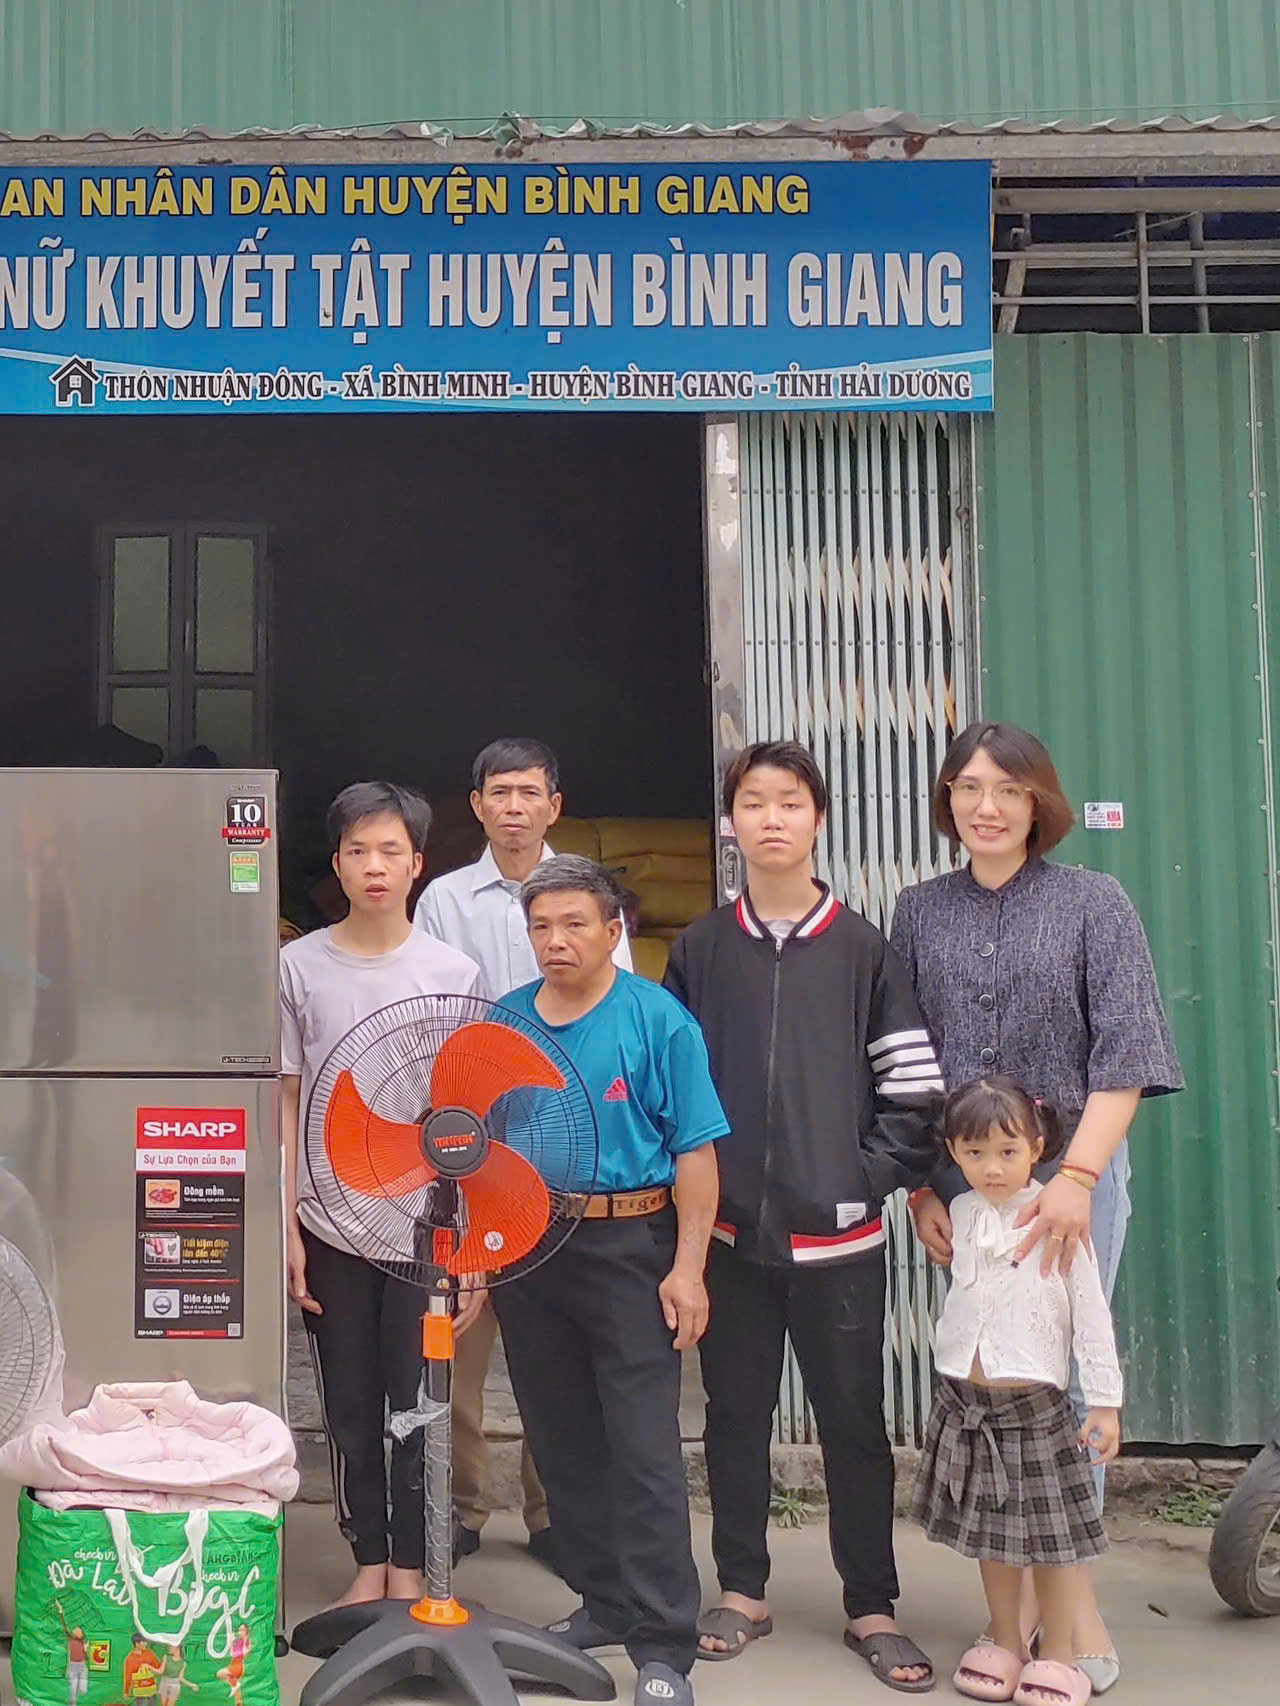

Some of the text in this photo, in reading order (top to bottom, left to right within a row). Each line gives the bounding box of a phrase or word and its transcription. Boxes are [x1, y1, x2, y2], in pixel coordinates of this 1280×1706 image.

[80, 167, 213, 216] NHÂN
[230, 167, 327, 215] DÂN
[344, 168, 508, 223] HUYỆN
[524, 167, 640, 215] BÌNH
[657, 176, 810, 215] GIANG
[86, 228, 295, 329] KHUYẾT
[312, 241, 410, 344] TẬT
[430, 239, 612, 344] HUYỆN
[633, 238, 767, 327] BÌNH
[788, 252, 962, 327] GIANG
[105, 371, 168, 399] THÔN
[174, 369, 251, 403] NHUẬN
[258, 369, 322, 398] ĐÔNG
[344, 368, 374, 397] XÃ
[381, 366, 440, 397] BÌNH
[447, 374, 508, 397] MINH
[530, 368, 608, 402] HUYỆN
[616, 366, 674, 397] BÌNH
[682, 374, 753, 397] GIANG
[775, 365, 832, 397] TỈNH
[840, 365, 881, 397] HẢI
[889, 371, 971, 398] DƯƠNG
[230, 804, 262, 823] 10
[143, 1121, 237, 1137] SHARP
[144, 1153, 237, 1167] Sự Lựa Chọn của Bạn
[615, 1192, 664, 1212] Tiger
[183, 1291, 231, 1305] Điện áp thấp
[74, 1547, 118, 1561] check in
[201, 1568, 240, 1583] heck in
